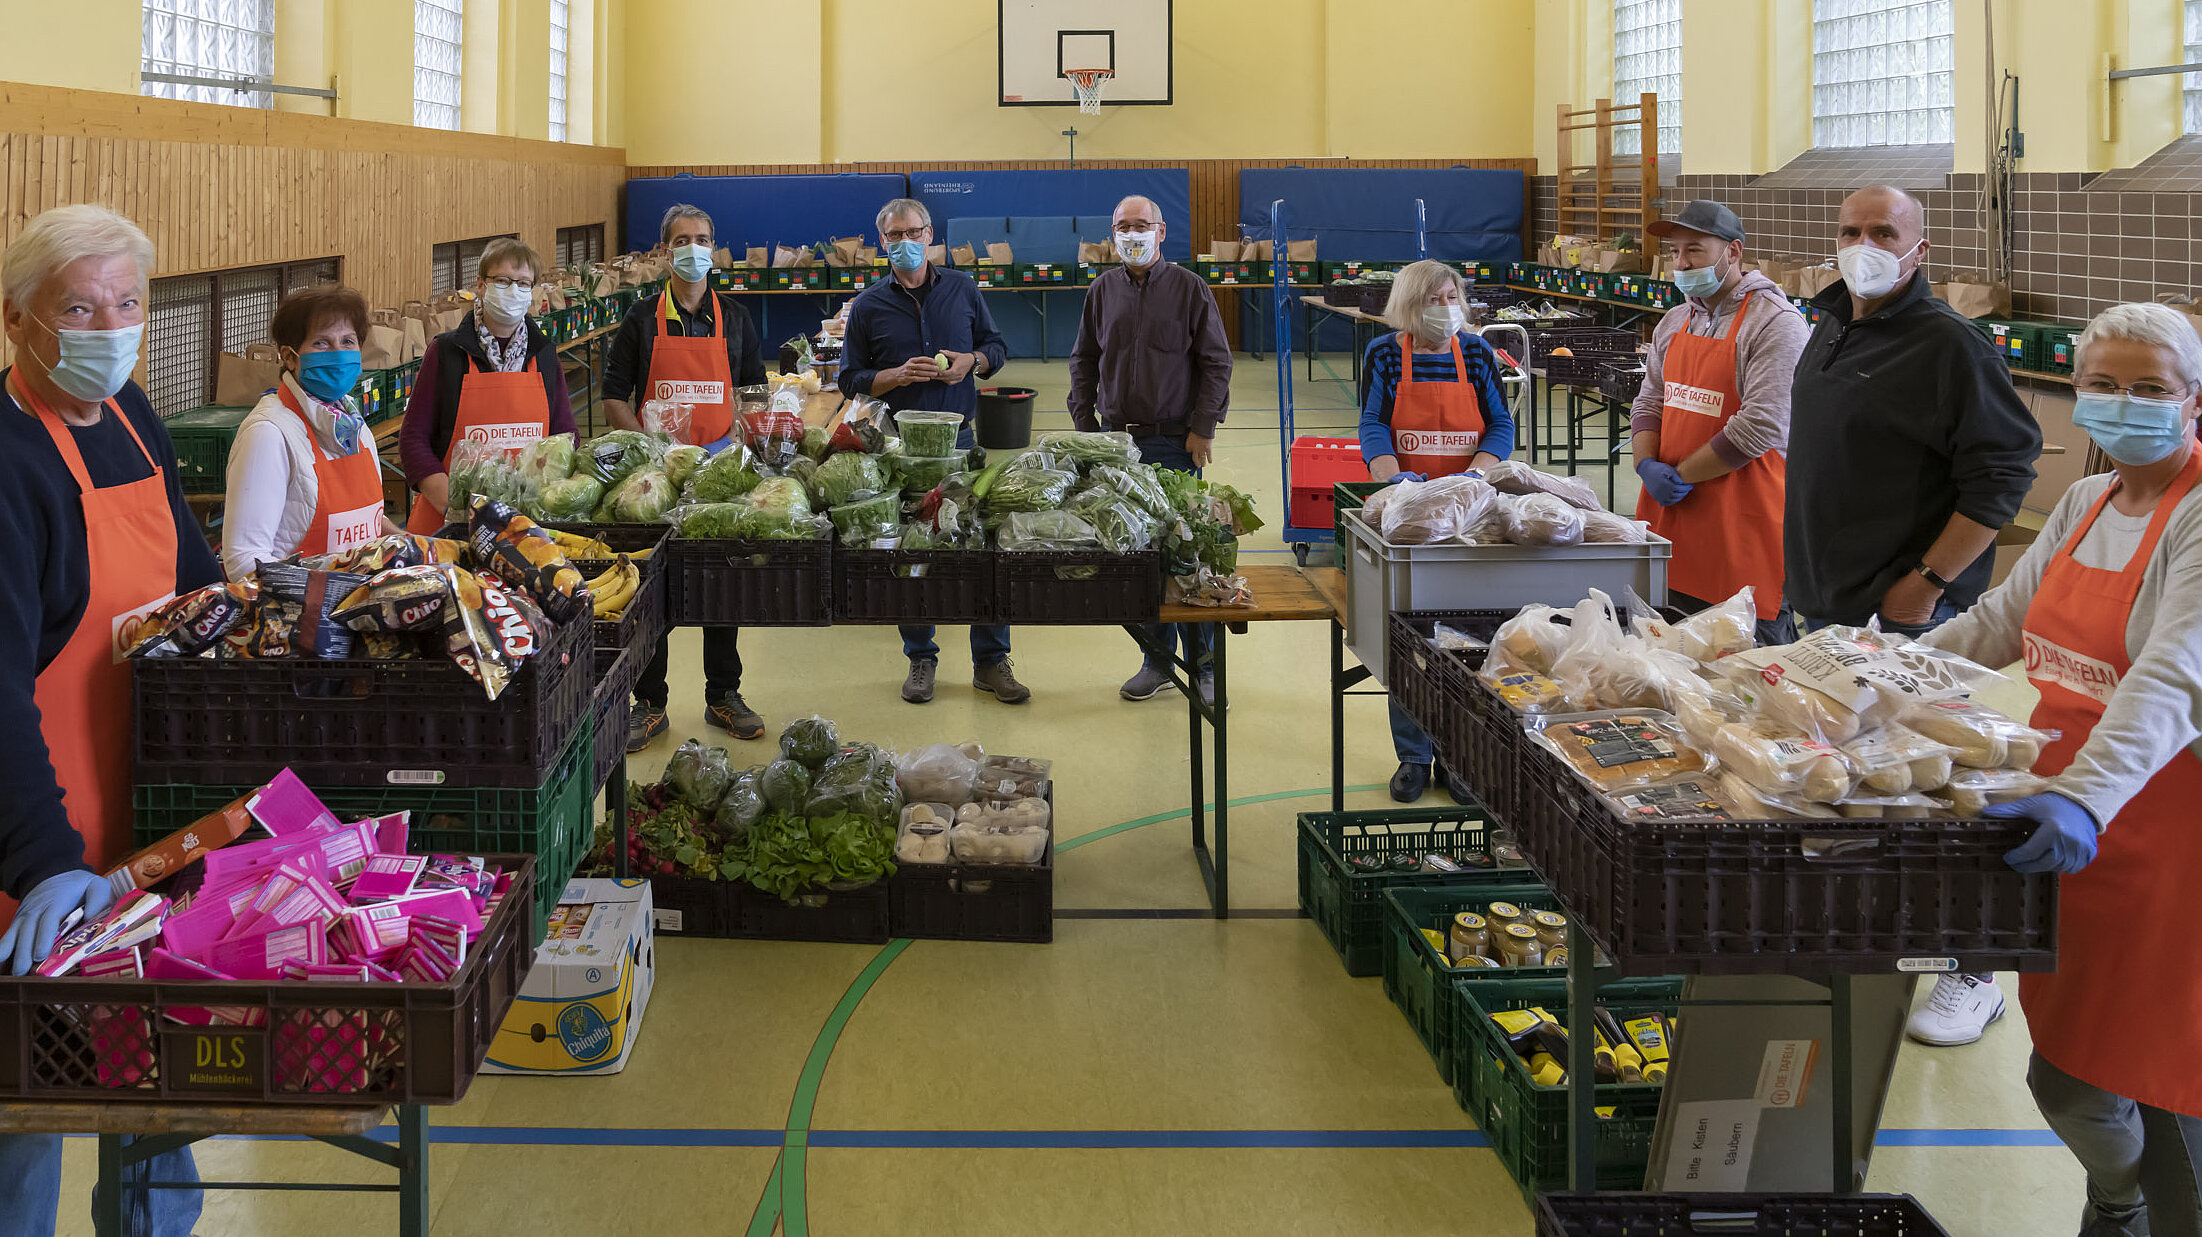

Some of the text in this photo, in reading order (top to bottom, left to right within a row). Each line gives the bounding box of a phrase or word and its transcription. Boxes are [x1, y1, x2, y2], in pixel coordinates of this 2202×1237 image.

[675, 384, 723, 395] DIE TAFELN
[1673, 387, 1688, 399] DIE
[1688, 390, 1722, 407] TAFELN
[491, 426, 542, 439] DIE TAFELN
[1421, 435, 1477, 446] DIE TAFELN
[335, 522, 371, 546] TAFEL
[194, 603, 228, 637] Chio
[402, 598, 442, 625] Chio
[483, 588, 534, 658] Chio
[2042, 645, 2065, 668] DIE
[59, 920, 103, 956] Alpia
[196, 1035, 246, 1069] DLS
[567, 1026, 611, 1056] Chiquita
[1779, 1043, 1796, 1072] TAFELN
[1774, 1074, 1788, 1088] DIE
[1686, 1118, 1709, 1180] Bitte Kisten
[1724, 1122, 1743, 1166] Säubern
